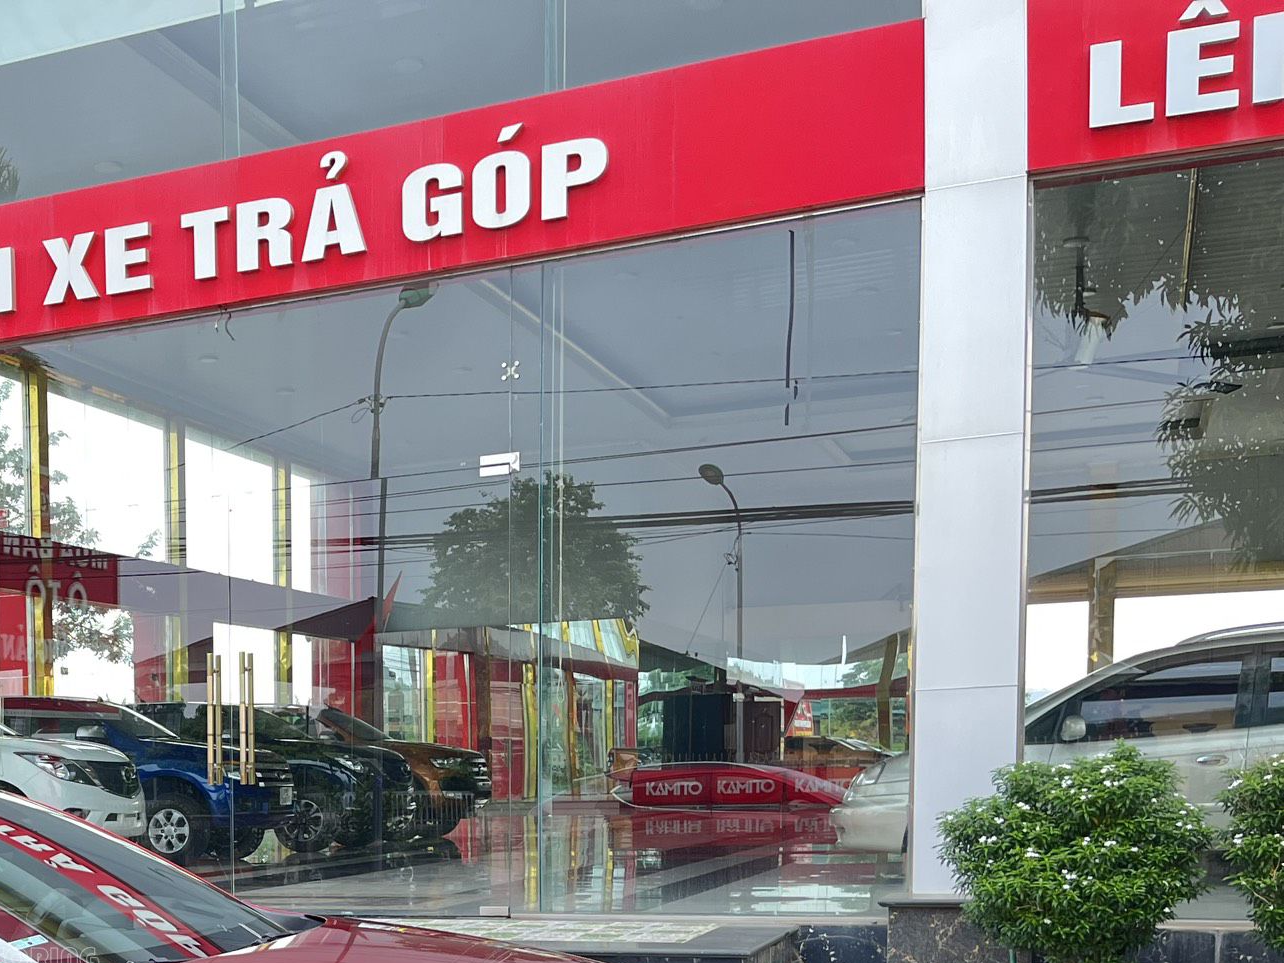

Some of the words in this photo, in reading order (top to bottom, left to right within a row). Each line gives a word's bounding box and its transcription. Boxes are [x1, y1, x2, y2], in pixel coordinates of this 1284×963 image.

[42, 221, 153, 306] XE
[180, 150, 368, 282] TRẢ
[401, 122, 609, 243] GÓP
[646, 780, 702, 796] KAMITO
[717, 779, 775, 795] KAMITO
